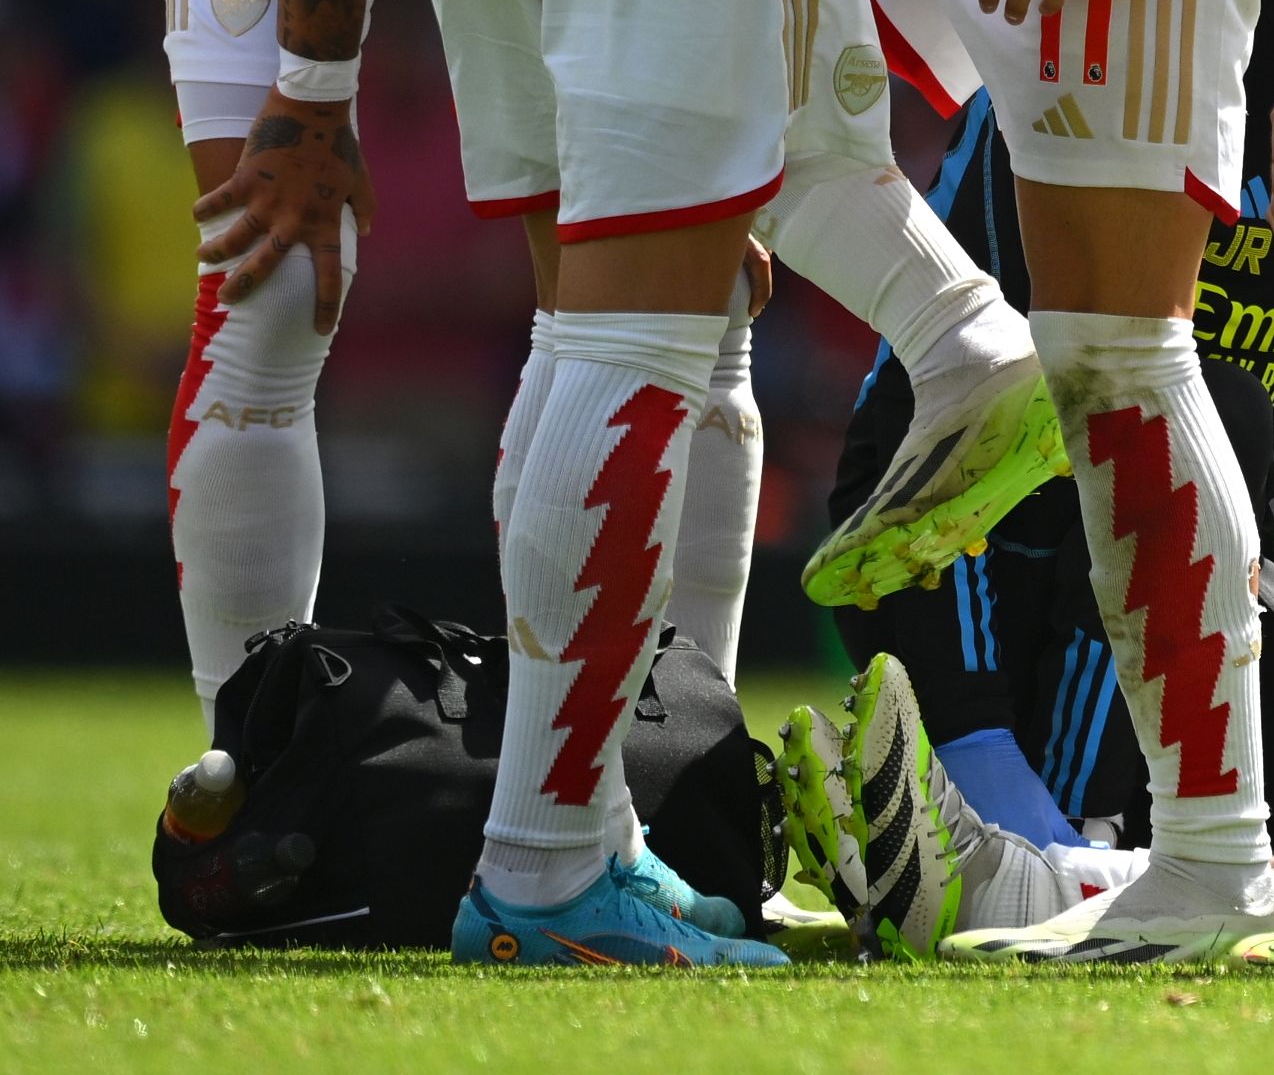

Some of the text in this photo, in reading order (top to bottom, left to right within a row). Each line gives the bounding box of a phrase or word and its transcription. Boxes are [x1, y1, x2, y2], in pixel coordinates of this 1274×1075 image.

[1203, 224, 1273, 275] JR
[201, 400, 296, 432] AFC
[696, 405, 760, 445] AF
